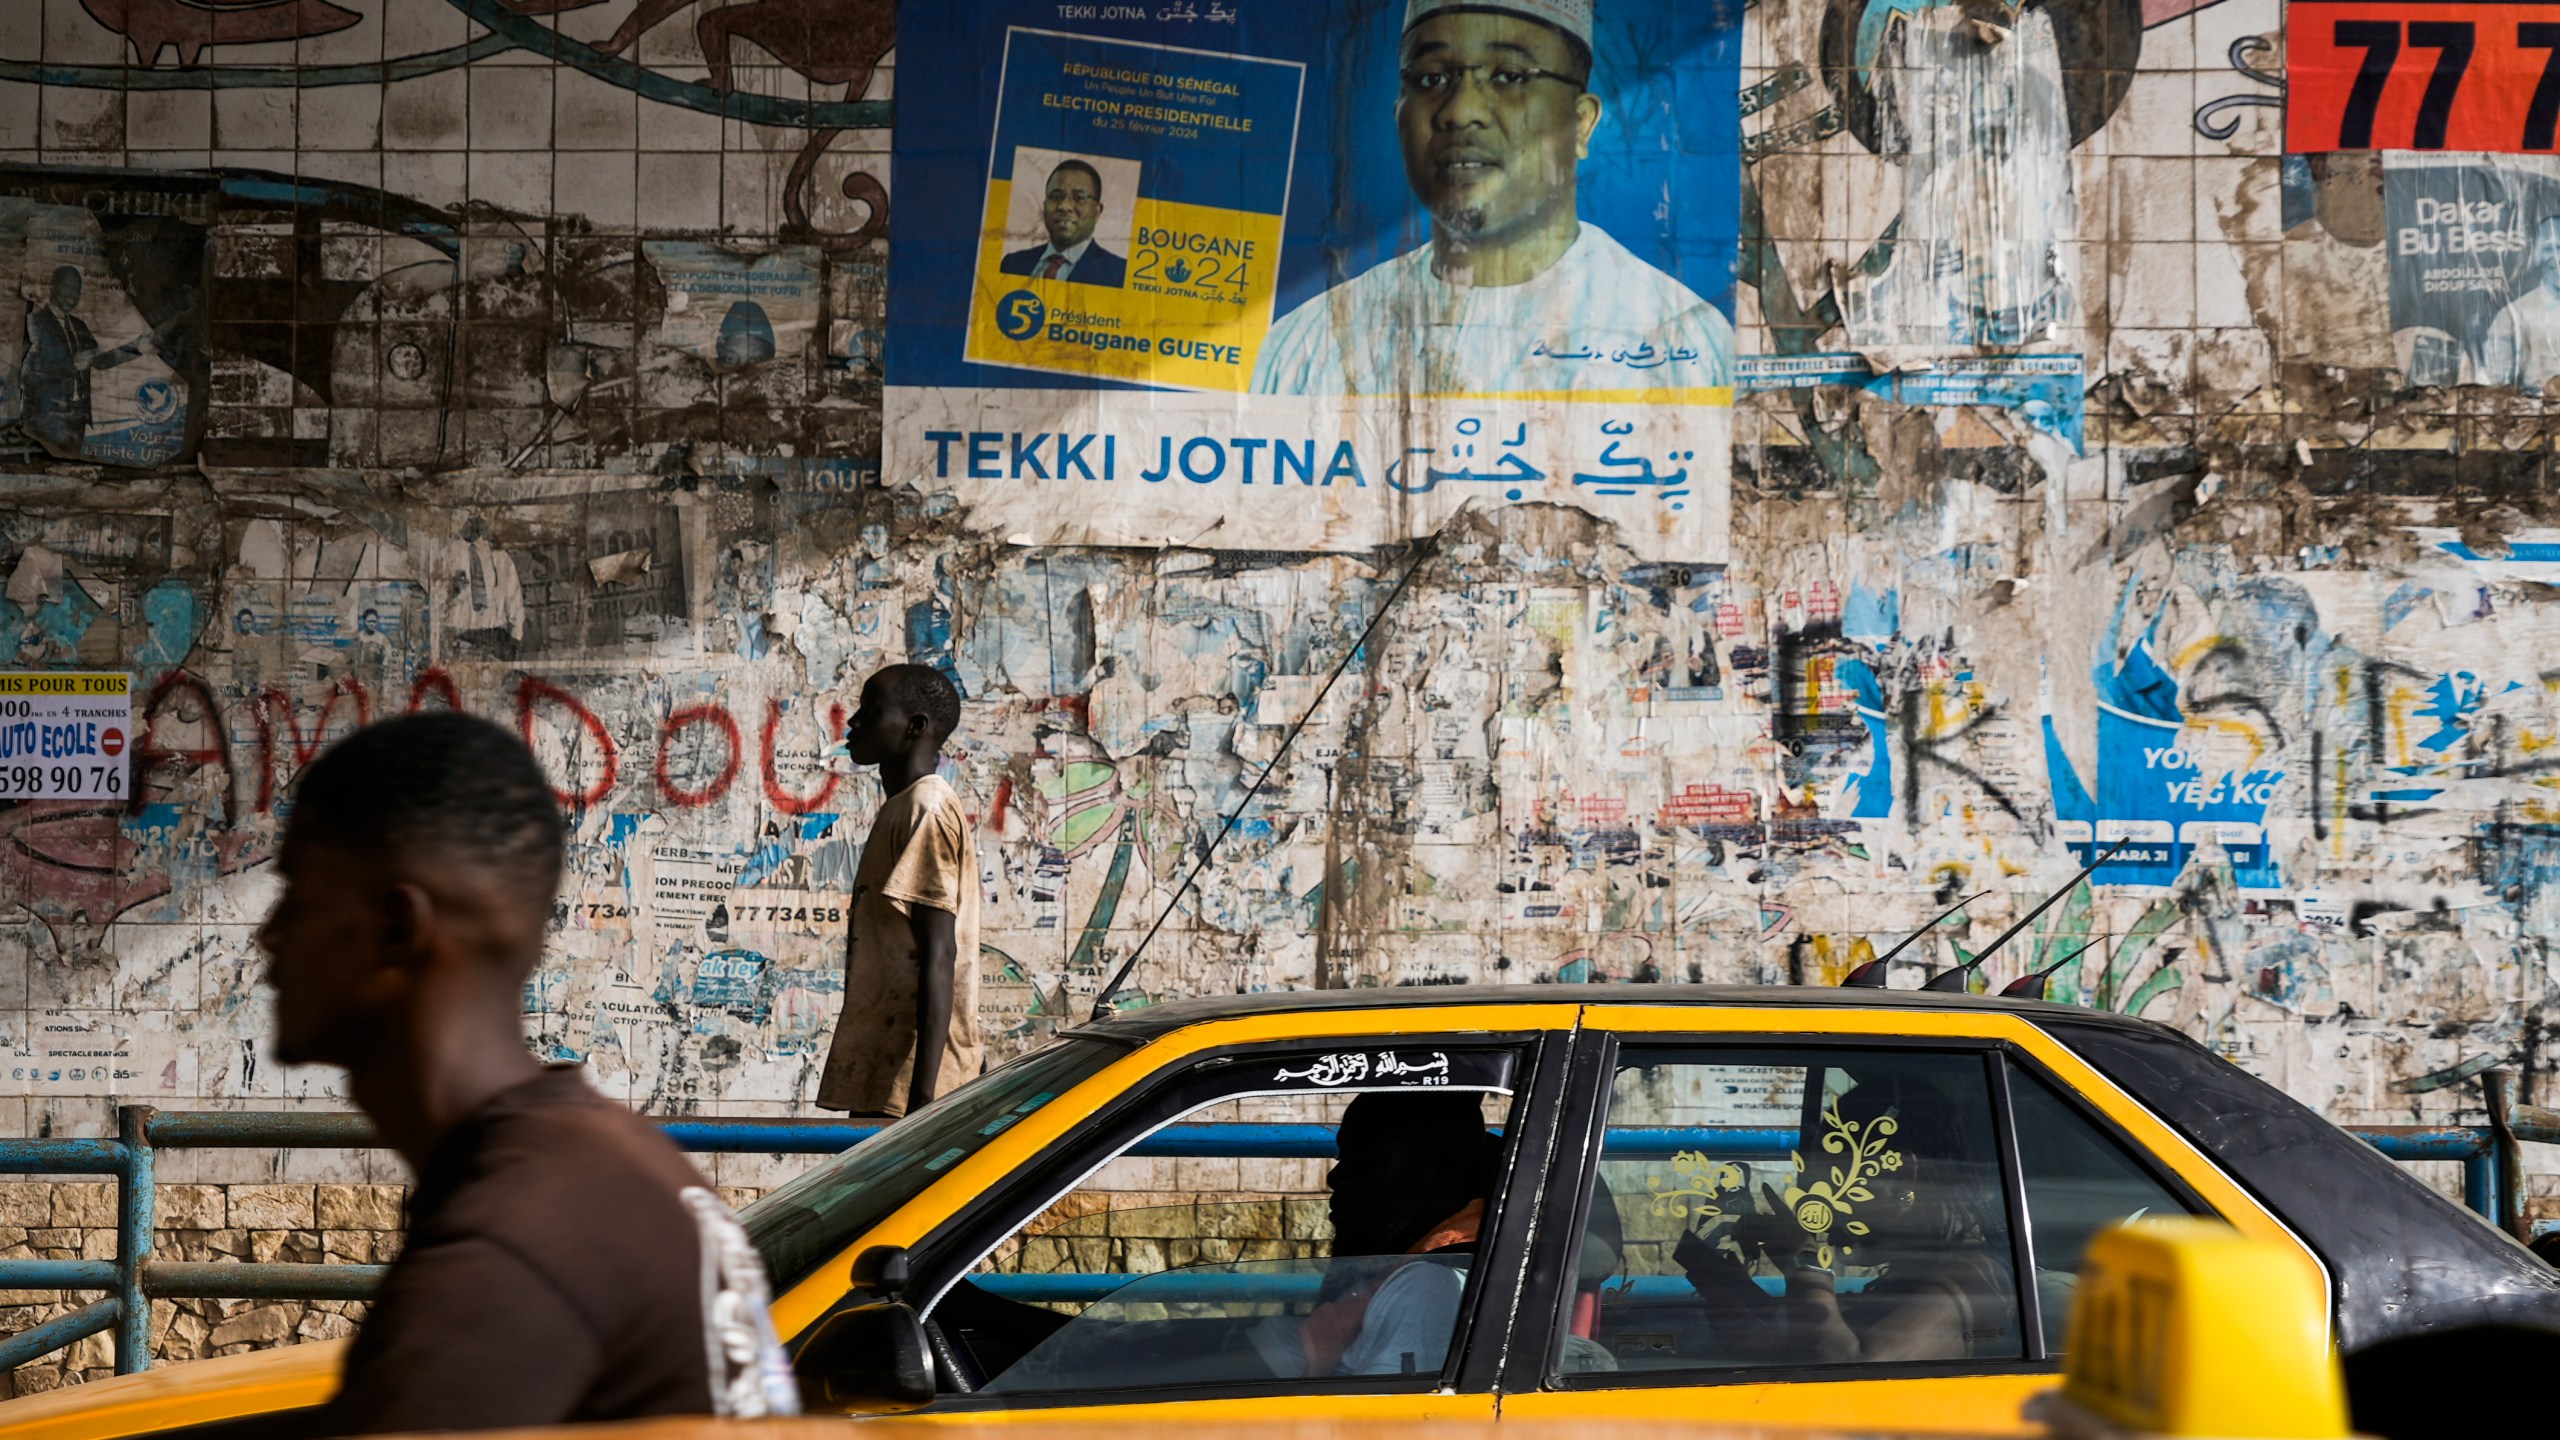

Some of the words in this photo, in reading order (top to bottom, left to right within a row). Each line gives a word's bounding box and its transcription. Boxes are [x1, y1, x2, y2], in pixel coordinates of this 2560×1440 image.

[1058, 5, 1096, 19] TEKKI
[1100, 6, 1146, 20] JOTNA
[1063, 62, 1149, 84] RÉPUBLIQUE
[1153, 75, 1173, 87] DU
[1177, 75, 1240, 96] SÉNÉGAL
[1084, 80, 1098, 91] Un
[1101, 83, 1135, 98] Peuple
[1138, 86, 1153, 97] Un
[1156, 89, 1174, 100] But
[1177, 92, 1196, 103] Une
[1043, 93, 1120, 115] ELECTION
[1124, 105, 1253, 132] PRESIDENTIELLE
[1092, 116, 1108, 128] du
[1111, 118, 1125, 130] 25
[1128, 119, 1165, 135] février
[1168, 126, 1198, 139] 2024
[2417, 198, 2507, 225] Dakar
[1138, 227, 1255, 260] BOUGANE
[2399, 228, 2441, 256] Bu
[689, 272, 720, 281] POUR
[1132, 282, 1162, 295] TEKKI
[1164, 285, 1198, 299] JOTNA
[1050, 308, 1121, 329] Président
[1048, 323, 1150, 353] Bougane
[1158, 337, 1241, 365] GUEYE
[103, 444, 135, 460] liste
[924, 430, 1115, 481] TEKKI
[1140, 436, 1366, 488] JOTNA
[29, 678, 76, 692] POUR
[82, 678, 127, 692] TOUS
[0, 701, 31, 717] 00
[62, 705, 70, 718] 4
[74, 709, 127, 718] TRANCHES
[42, 721, 96, 759] ECOLE
[51, 766, 82, 793] 90
[90, 766, 121, 793] 76
[2124, 828, 2153, 837] Savoir
[735, 906, 759, 921] 77
[767, 906, 807, 921] 734
[812, 907, 841, 922] 58
[1423, 1076, 1449, 1085] R19
